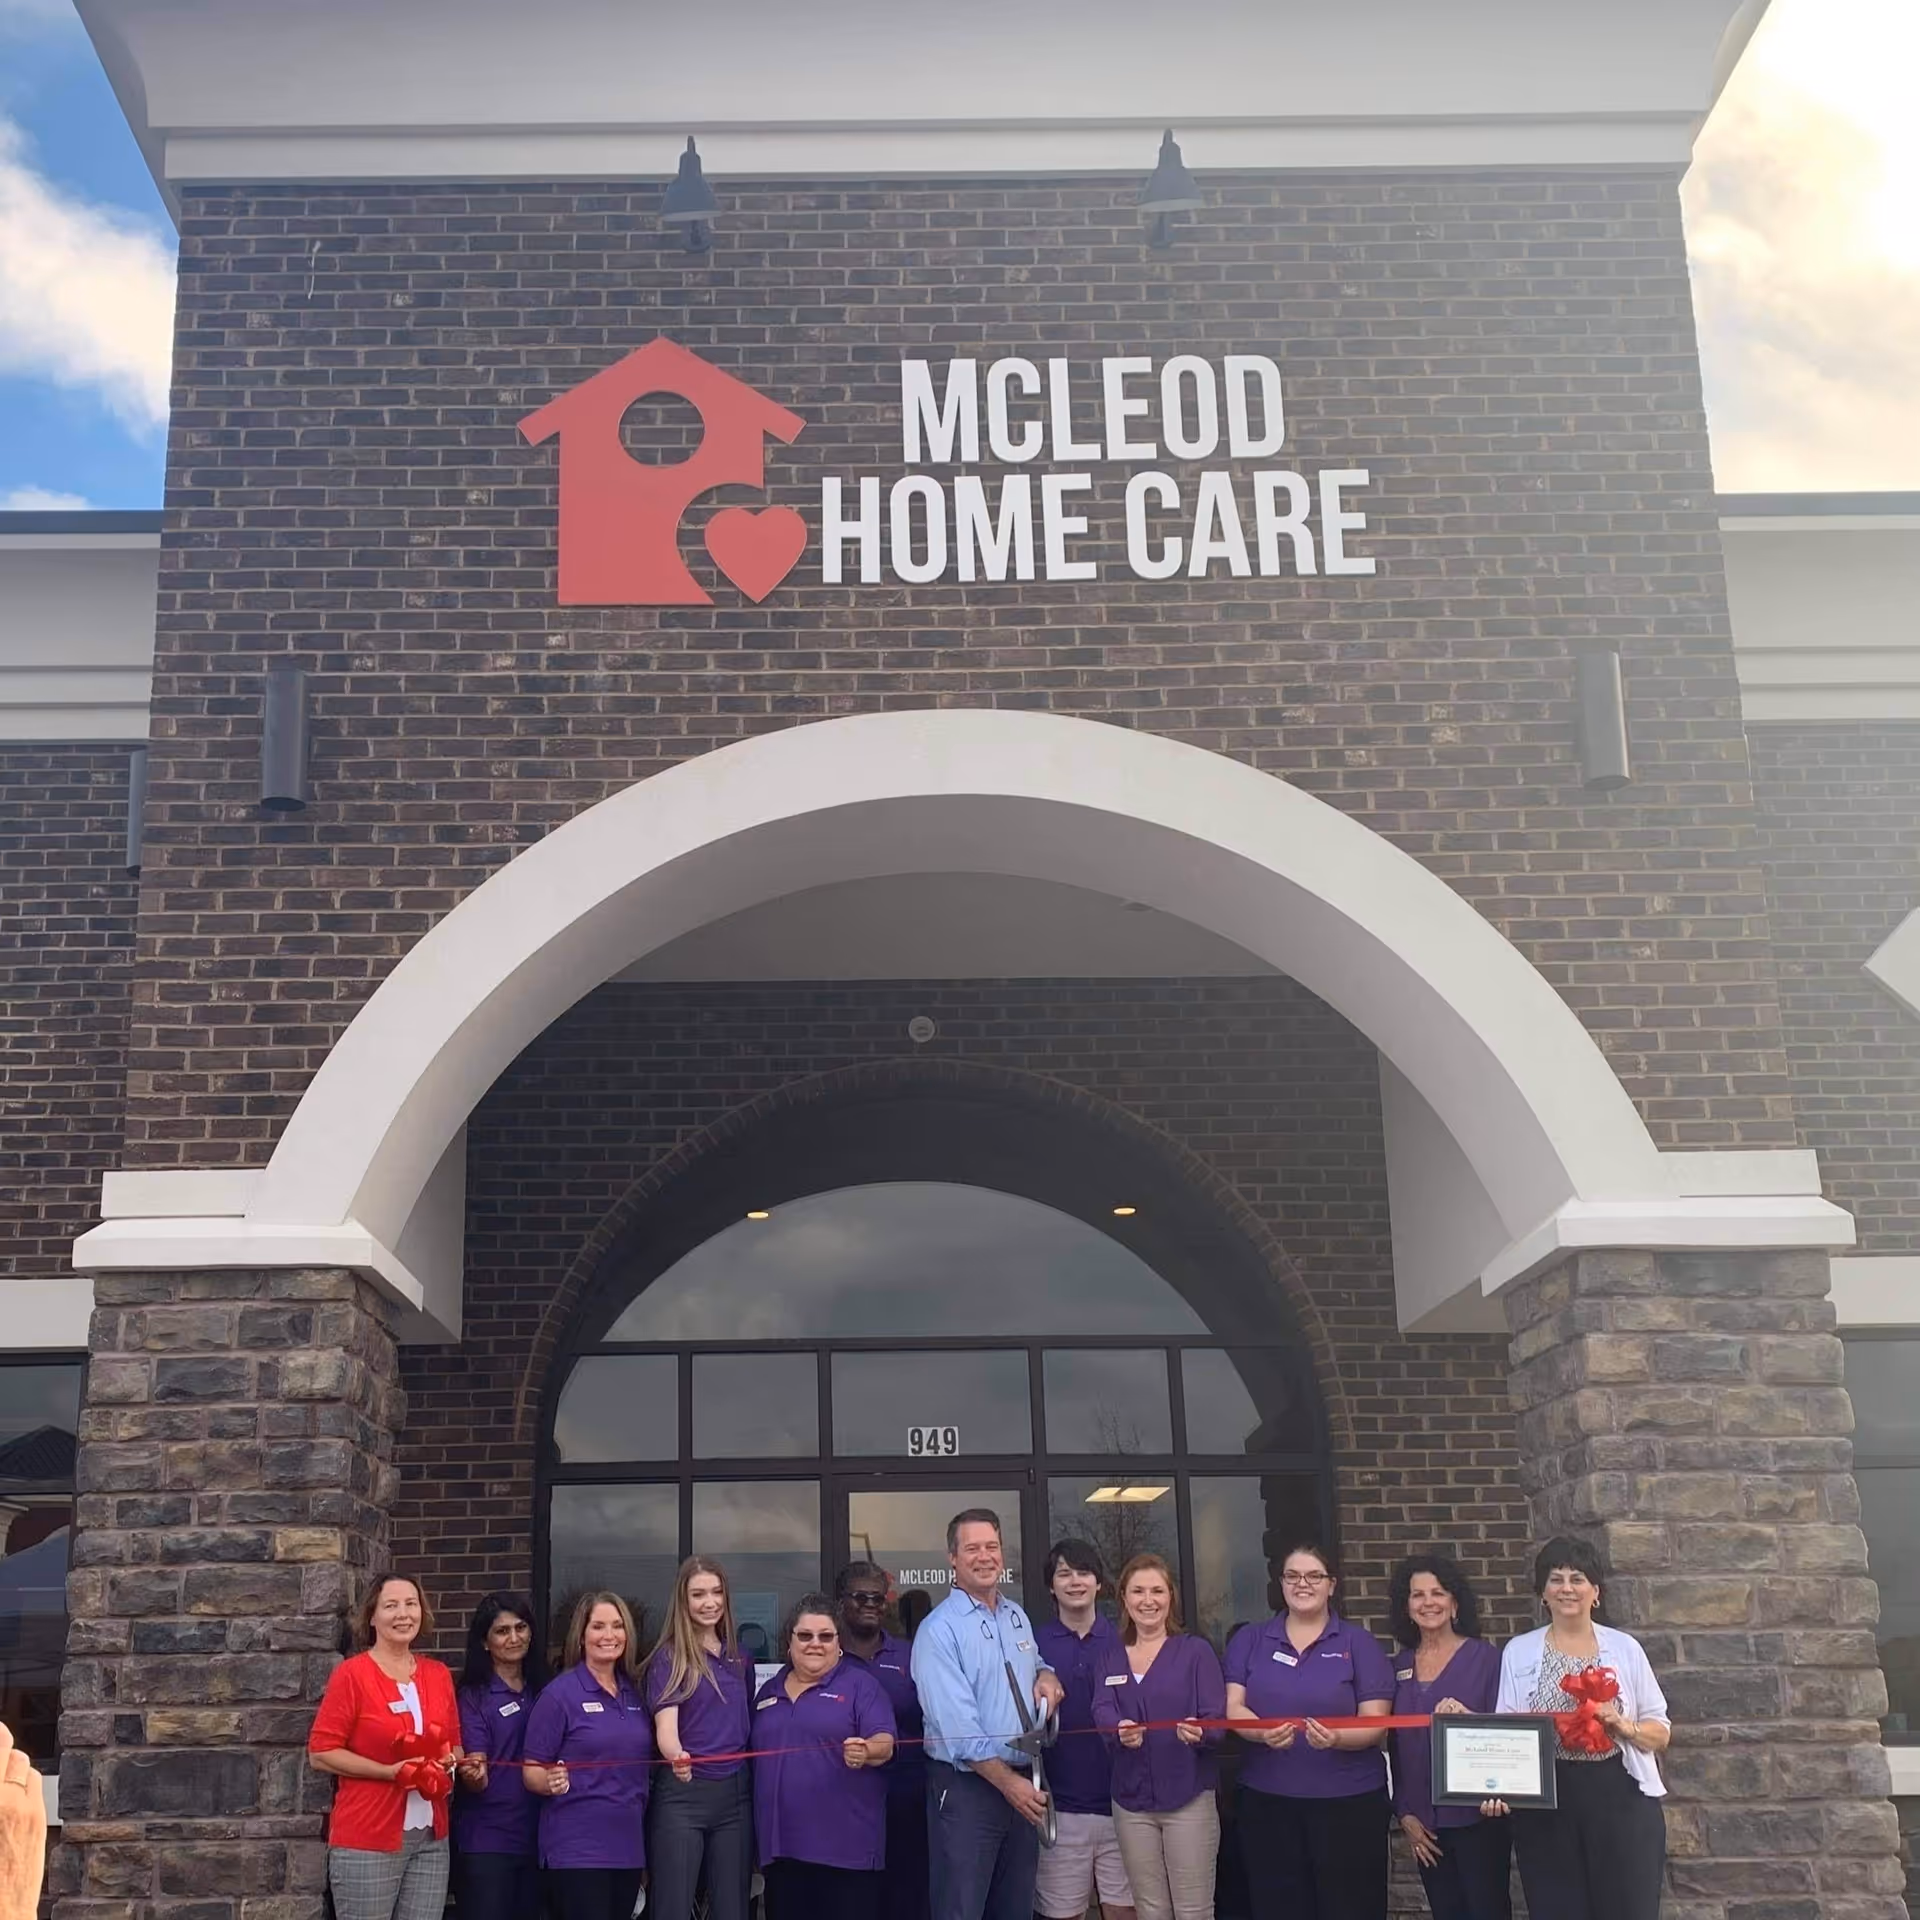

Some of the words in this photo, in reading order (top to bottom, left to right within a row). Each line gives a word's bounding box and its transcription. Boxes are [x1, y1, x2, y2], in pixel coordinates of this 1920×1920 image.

[901, 354, 1285, 464] MCLEOD
[820, 472, 1098, 585] HOME
[1124, 466, 1377, 580] CARE
[910, 1427, 957, 1455] 949
[900, 1569, 946, 1585] MCLEOD
